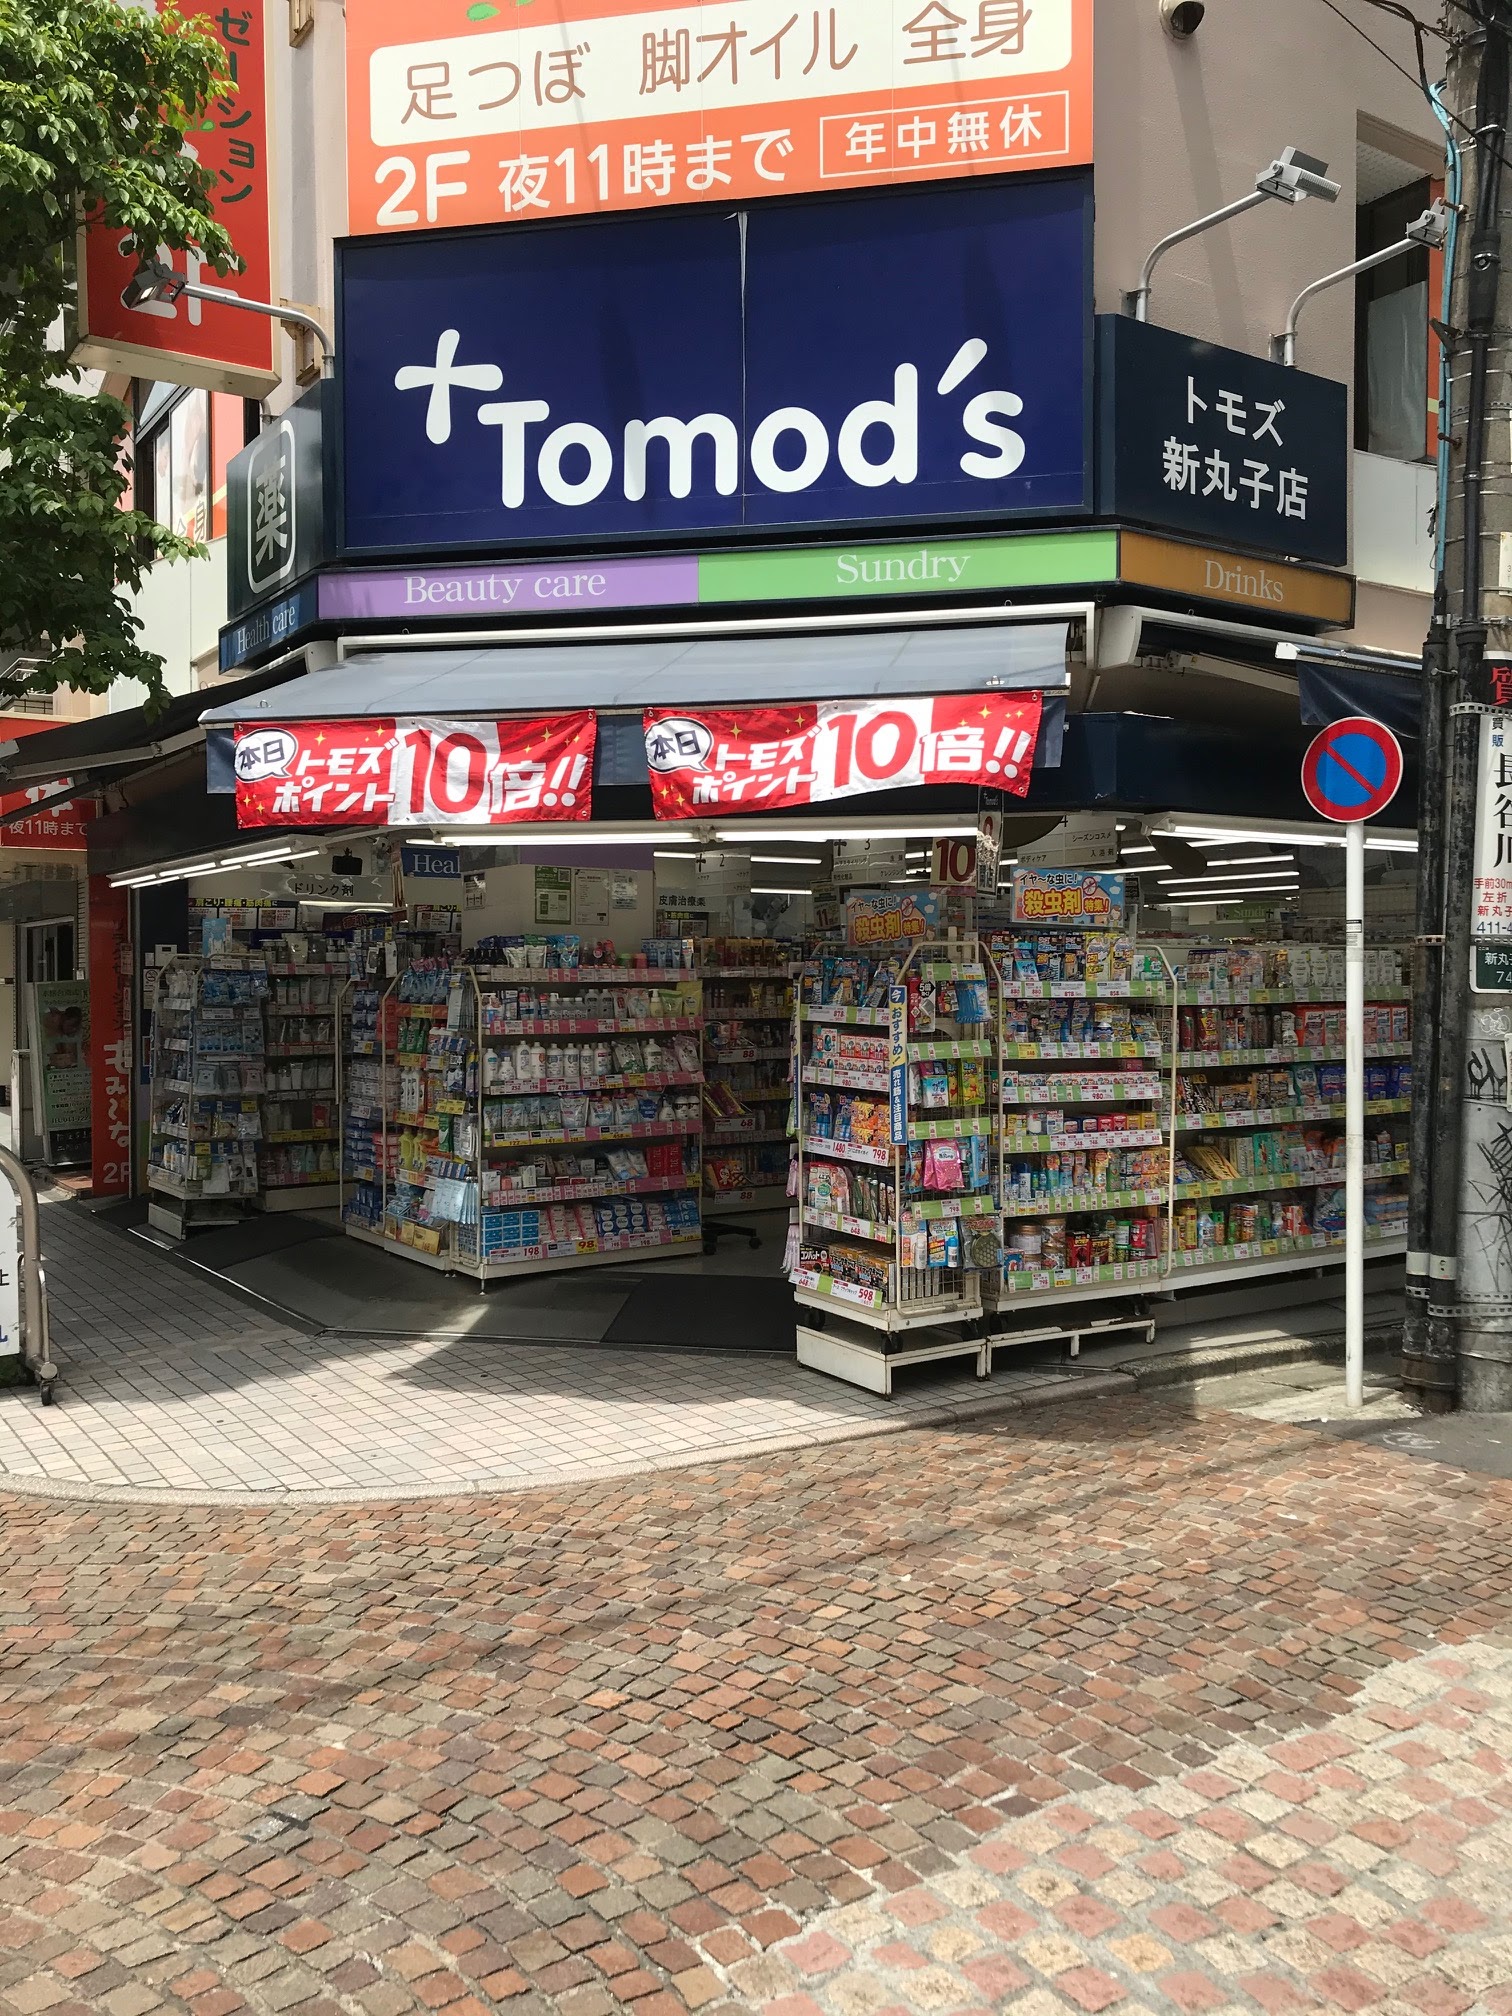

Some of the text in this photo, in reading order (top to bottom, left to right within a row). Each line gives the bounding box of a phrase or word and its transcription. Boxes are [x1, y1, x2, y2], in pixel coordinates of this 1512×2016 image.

[401, 0, 1032, 124] 足つぼ 脚オイル 全身
[845, 104, 1042, 164] 年中無休
[374, 128, 794, 226] 2F 夜11時まで
[477, 338, 1026, 509] Tomod's
[1184, 375, 1286, 447] トモズ
[1162, 435, 1310, 520] 新丸子店
[254, 455, 287, 567] 薬
[836, 548, 971, 586] Sundry
[1203, 559, 1285, 603] Drinks
[403, 571, 607, 604] Beauty care
[236, 604, 296, 654] Health care
[237, 738, 286, 771] 本日
[295, 737, 399, 776] トモズ
[650, 730, 701, 761] 本日
[714, 724, 822, 772] トモズ
[271, 775, 395, 814] ポイント
[692, 765, 818, 805] ポイント
[720, 853, 725, 867] 2
[294, 882, 354, 896] ドリンク剤
[1023, 888, 1083, 917] 殺虫剤
[1483, 891, 1507, 903] 左折
[854, 910, 902, 945] 殺虫剤
[890, 989, 902, 1002] 今
[891, 1006, 903, 1065] おすすめ!
[873, 1149, 886, 1160] 798
[523, 1246, 540, 1257] 198
[577, 1240, 595, 1250] 98
[858, 1288, 873, 1301] 598
